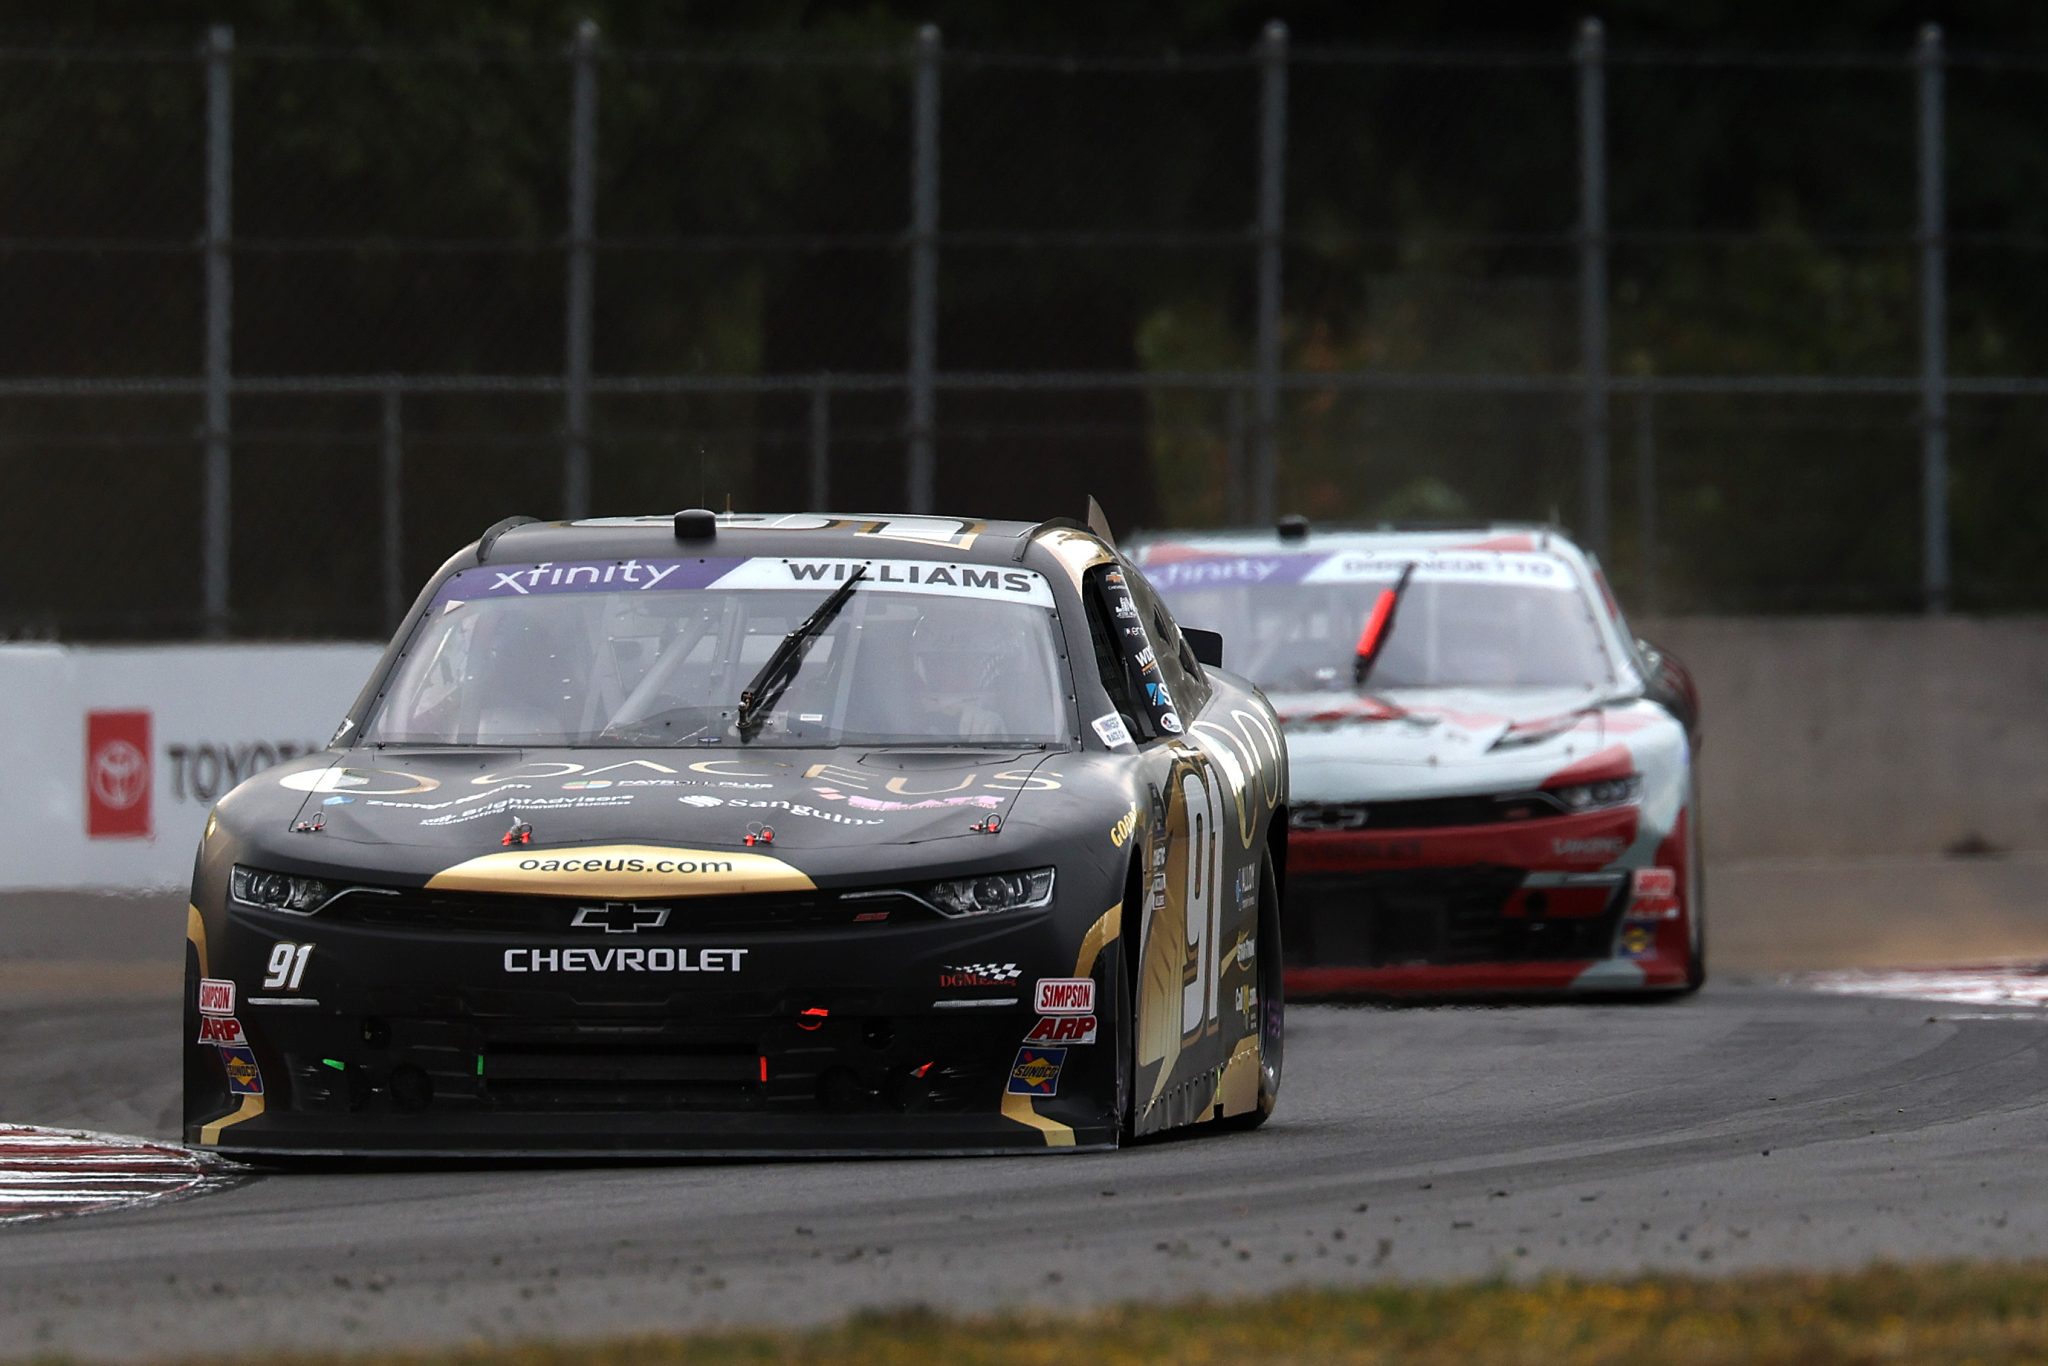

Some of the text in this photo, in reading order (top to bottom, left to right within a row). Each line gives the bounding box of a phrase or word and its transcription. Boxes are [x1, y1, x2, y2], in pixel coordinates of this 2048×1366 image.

[489, 560, 680, 594] xfinity
[789, 564, 1031, 592] WILLIAMS
[167, 740, 319, 803] TOY
[519, 858, 733, 873] oaceus.com
[1183, 763, 1225, 1035] 91
[263, 943, 314, 989] 91
[504, 949, 748, 972] CHEVROLET
[940, 973, 979, 987] DGM
[201, 984, 231, 1009] SIMPSON
[1041, 984, 1091, 1008] SIMPSON
[201, 1018, 241, 1041] ARP
[1028, 1017, 1096, 1040] ARP
[228, 1065, 257, 1077] SUNOCO
[1014, 1065, 1059, 1078] SUNOCO
